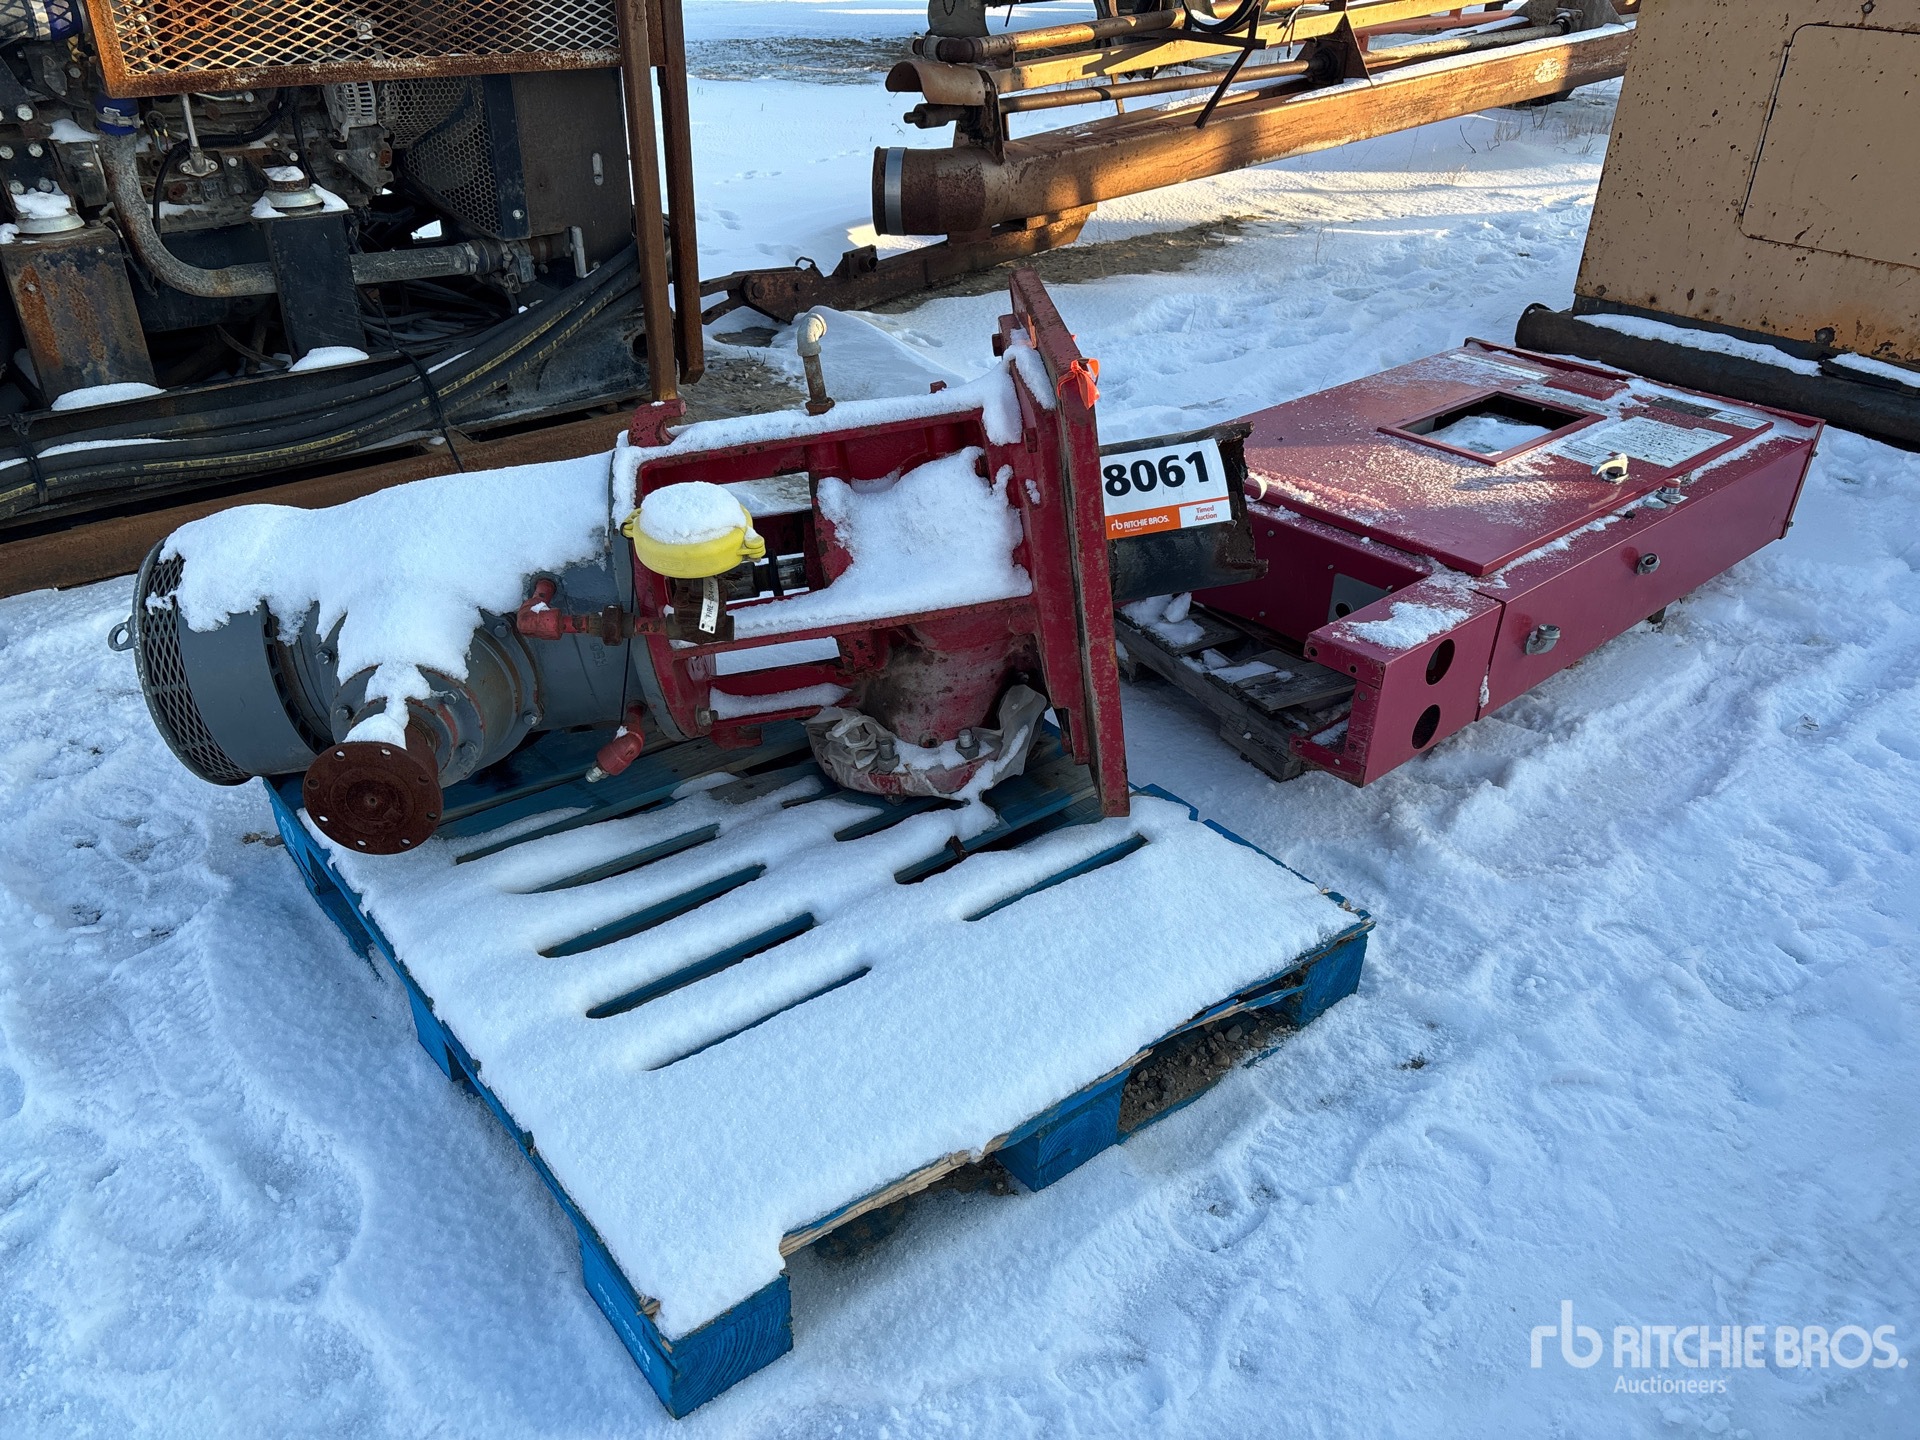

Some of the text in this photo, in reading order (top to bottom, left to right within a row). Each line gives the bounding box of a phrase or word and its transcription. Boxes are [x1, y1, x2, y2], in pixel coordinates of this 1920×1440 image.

[1103, 451, 1209, 496] 8061
[1196, 505, 1214, 513] Timed
[1195, 512, 1217, 521] Auction
[1124, 518, 1148, 528] RITCHIE
